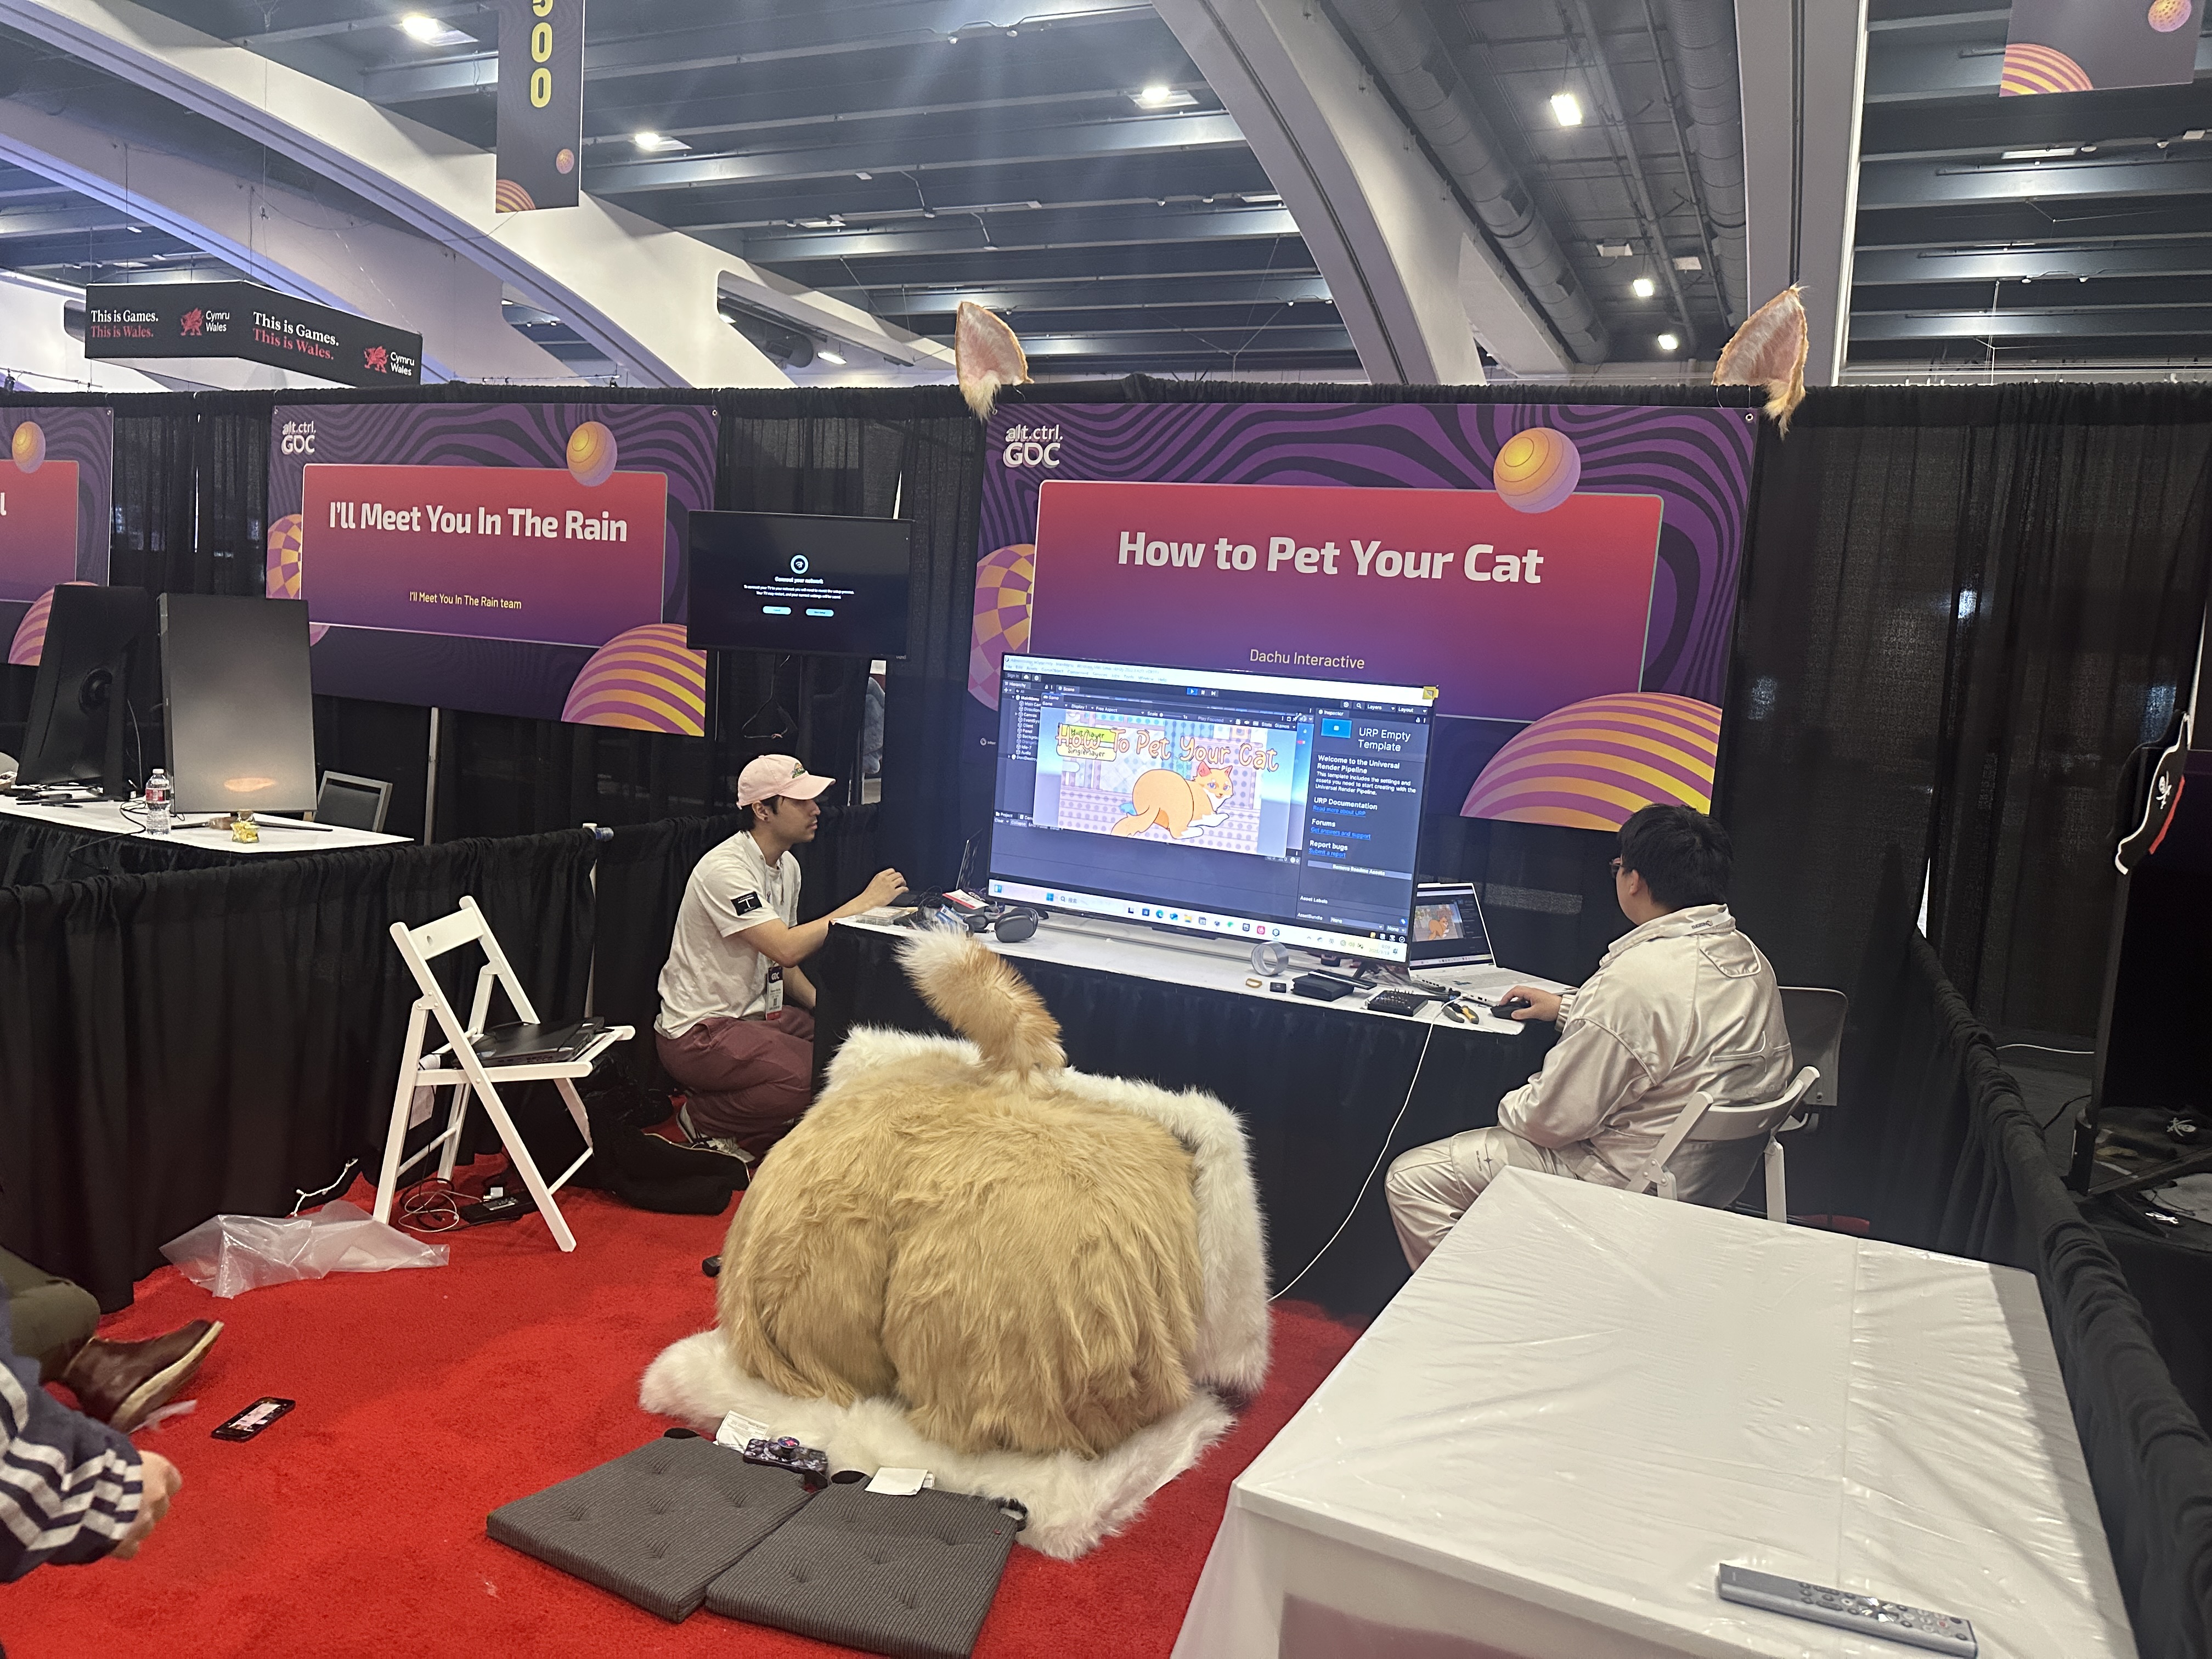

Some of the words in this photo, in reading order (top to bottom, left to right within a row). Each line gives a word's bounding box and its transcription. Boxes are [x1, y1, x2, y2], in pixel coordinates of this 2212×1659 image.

[91, 310, 111, 322] This
[114, 310, 121, 322] is
[123, 310, 159, 322] Games.
[206, 311, 229, 321] Cymru
[91, 325, 110, 337] This
[114, 325, 121, 337] is
[123, 325, 154, 337] Wales.
[206, 323, 227, 332] Wales
[253, 312, 281, 331] This
[284, 319, 294, 334] is
[296, 324, 339, 346] Games.
[253, 328, 281, 347] This
[284, 336, 293, 350] is
[296, 339, 334, 360] Wales.
[390, 352, 415, 366] Cymru
[391, 363, 412, 376] Wales
[283, 421, 317, 435] alt.ctrl.
[1005, 424, 1063, 442] alt.ctrl.
[281, 435, 315, 455] GDC
[1003, 442, 1060, 469] GDC
[360, 503, 421, 532] Meet
[426, 505, 471, 533] You
[478, 507, 501, 535] In
[507, 508, 558, 538] The
[565, 510, 627, 541] Rain
[1118, 531, 1206, 568] How
[1214, 538, 1257, 571] to
[1267, 536, 1340, 575] Pet
[1350, 540, 1454, 579] Your
[1464, 544, 1544, 584] Cat
[419, 592, 437, 603] Meet
[439, 594, 453, 604] You
[455, 594, 462, 605] In
[464, 595, 479, 606] The
[481, 596, 499, 607] Rain
[500, 599, 522, 610] team
[1250, 649, 1290, 664] Dachu
[1294, 652, 1365, 669] Interactive
[1359, 727, 1379, 737] URP
[1381, 730, 1411, 742] Empty
[1055, 722, 1101, 749] How
[1110, 728, 1130, 753] To
[1136, 729, 1171, 760] Pet
[1180, 736, 1231, 765] Your
[1239, 743, 1279, 772] Cat
[1358, 739, 1401, 752] Template
[1317, 763, 1340, 771] Render
[1341, 765, 1368, 774] Pipeline
[1318, 755, 1347, 764] Welcome
[1369, 760, 1400, 769] Universal
[1380, 777, 1400, 786] settings
[1328, 798, 1378, 810] Documentation
[1312, 819, 1336, 827] Forums
[1310, 840, 1331, 849] Report
[1332, 843, 1348, 851] bugs
